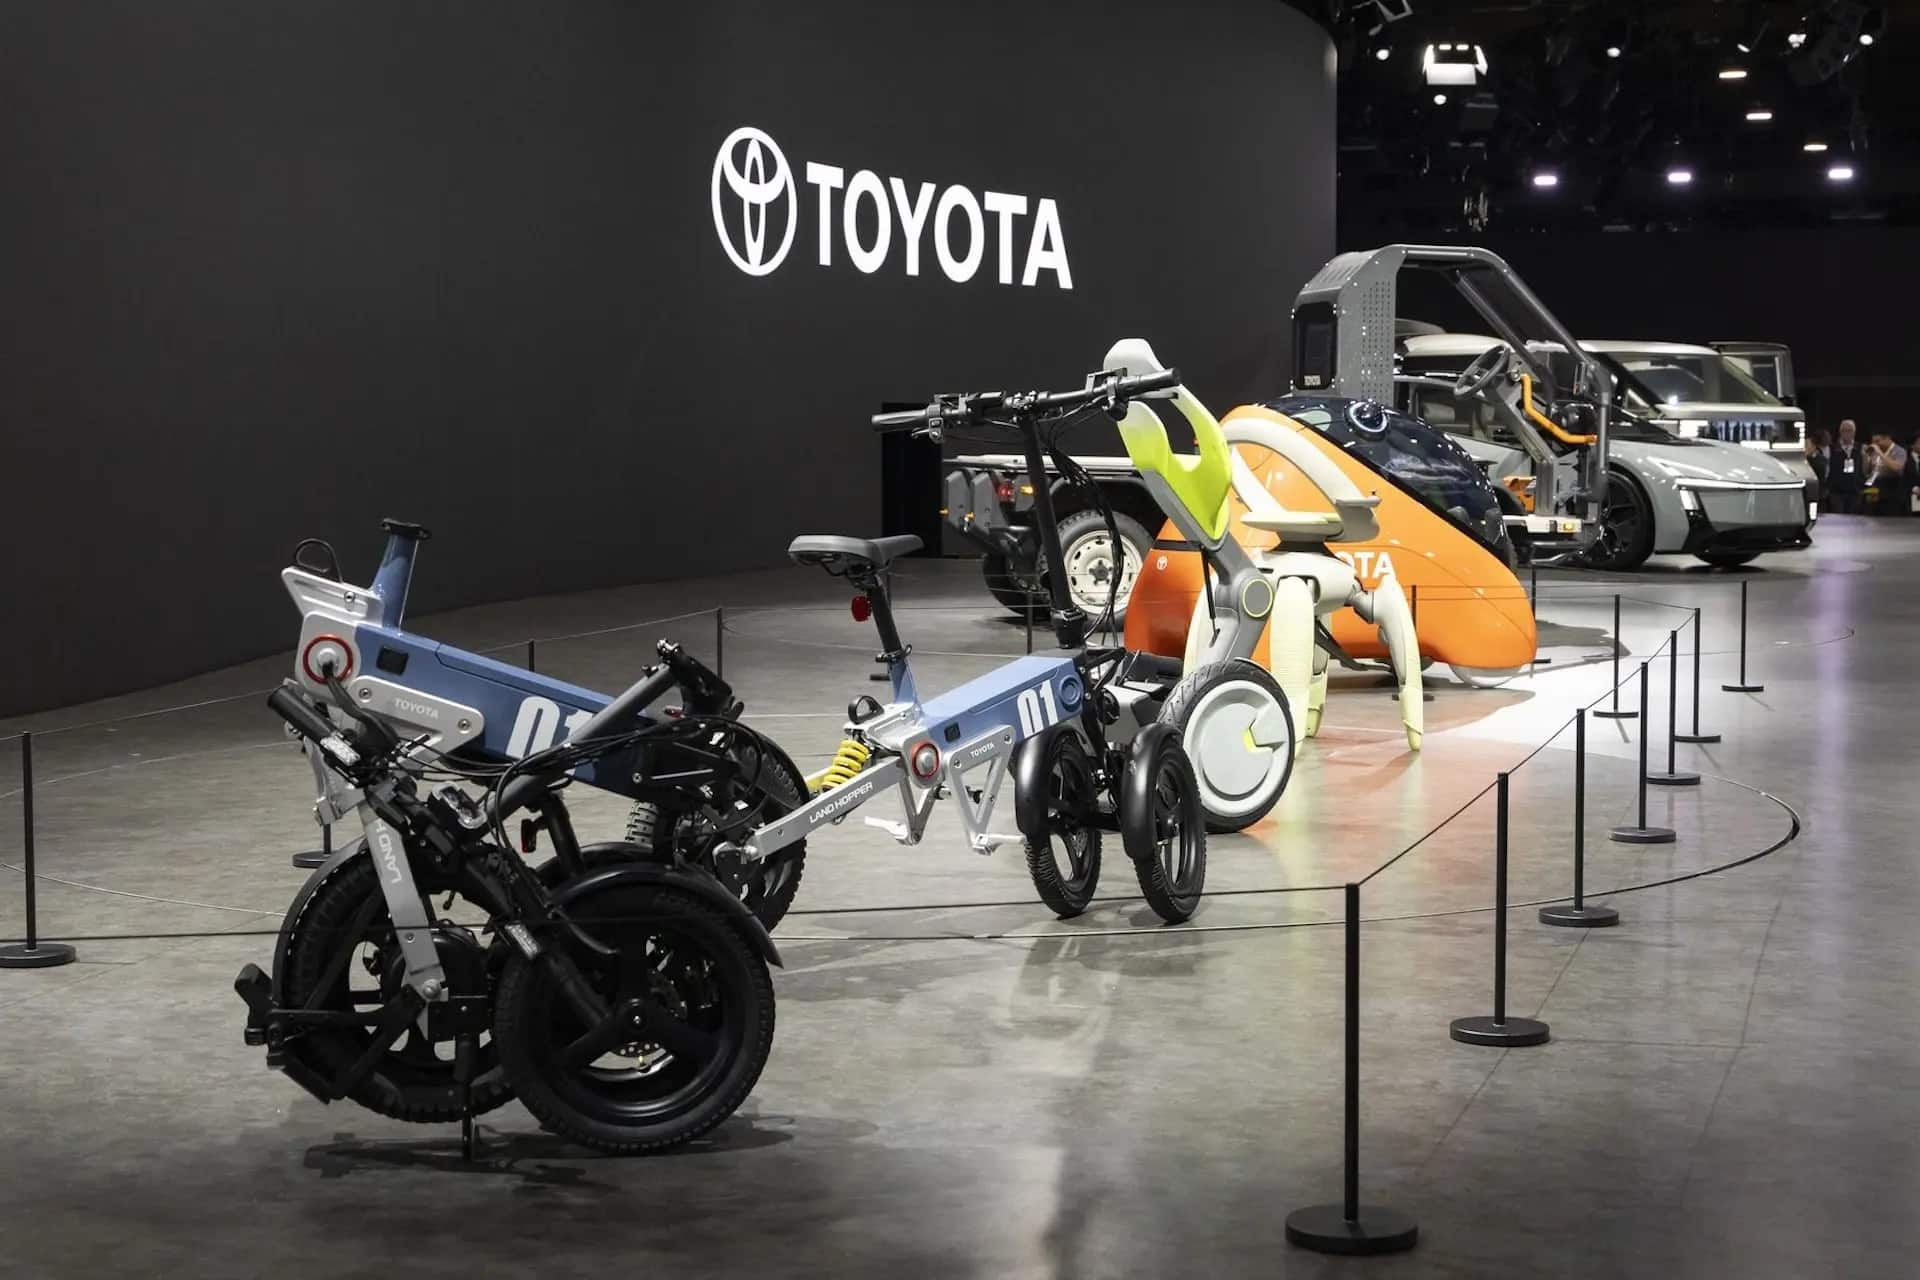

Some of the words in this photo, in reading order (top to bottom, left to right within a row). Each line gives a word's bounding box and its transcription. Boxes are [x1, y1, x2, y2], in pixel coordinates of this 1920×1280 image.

[806, 161, 1073, 290] TOYOTA
[394, 698, 440, 718] TOYOTA
[1016, 680, 1059, 737] 01
[970, 741, 994, 758] TOYOTA
[809, 803, 834, 823] LAND
[834, 782, 873, 809] HOPPER
[379, 833, 402, 884] LAND
